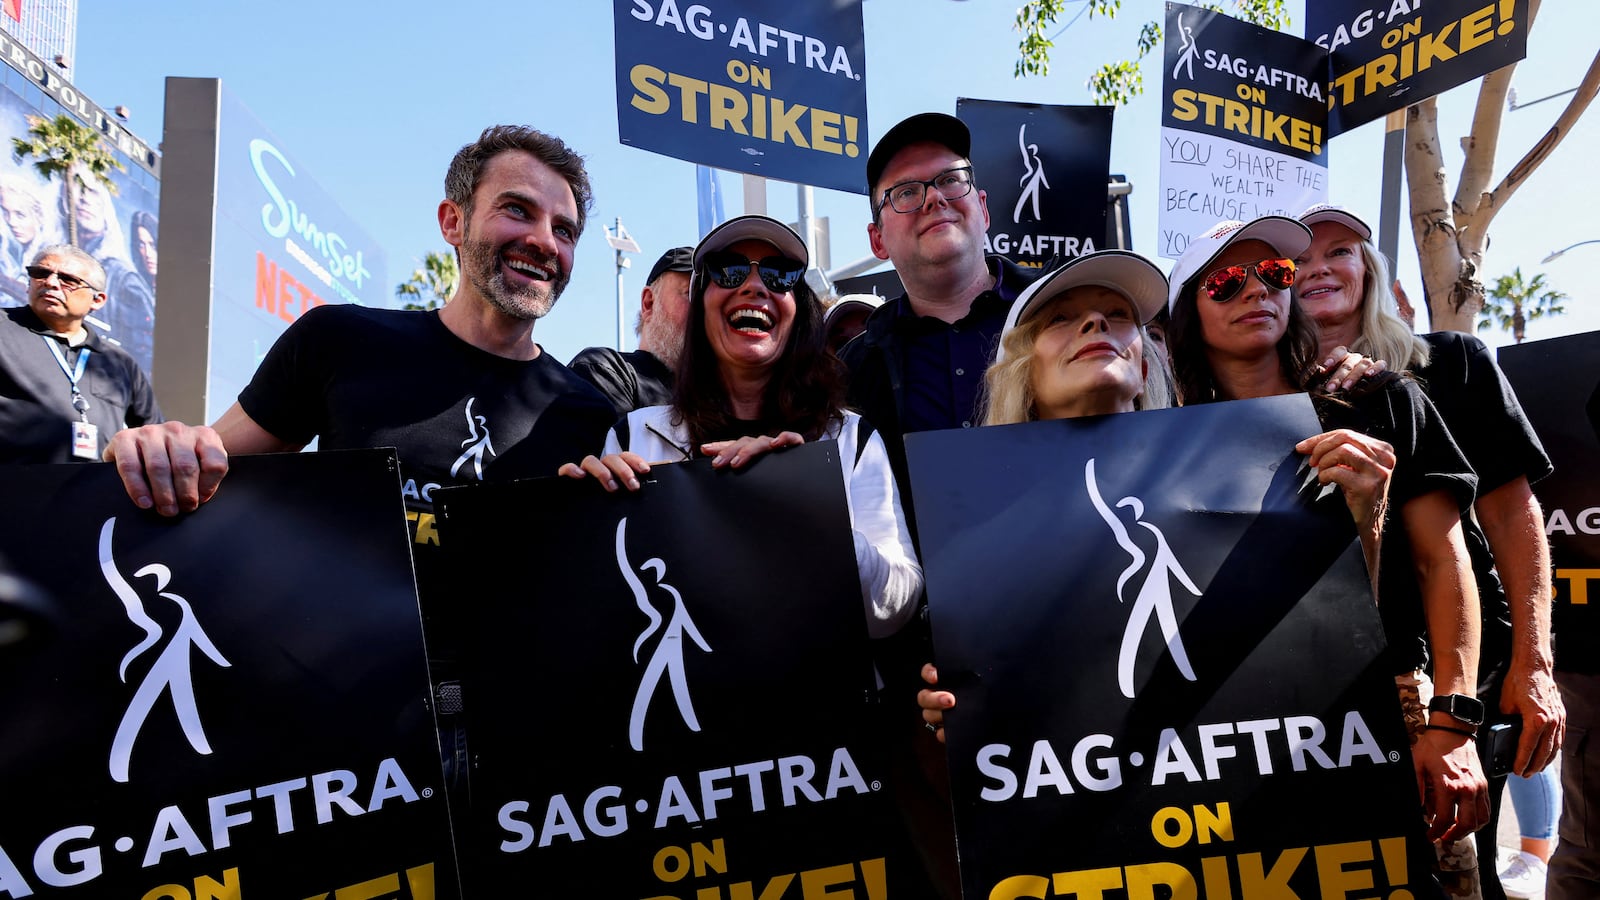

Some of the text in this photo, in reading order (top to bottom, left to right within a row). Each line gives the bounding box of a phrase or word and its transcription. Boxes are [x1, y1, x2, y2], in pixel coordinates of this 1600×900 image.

[1381, 16, 1422, 50] ON
[726, 59, 771, 91] ON
[1328, 0, 1516, 113] TRIKE!
[0, 34, 147, 162] TROPOLITN
[629, 63, 860, 158] STRIKE!
[1236, 83, 1266, 106] ON
[1171, 88, 1323, 156] STRIKE!
[1165, 136, 1323, 191] YOU SHARE THE
[1211, 172, 1275, 198] WEALTH
[1166, 188, 1247, 222] BECAUSE
[1163, 229, 1190, 254] YO
[255, 250, 328, 325] NET
[1150, 801, 1235, 848] ON
[652, 838, 728, 883] ON
